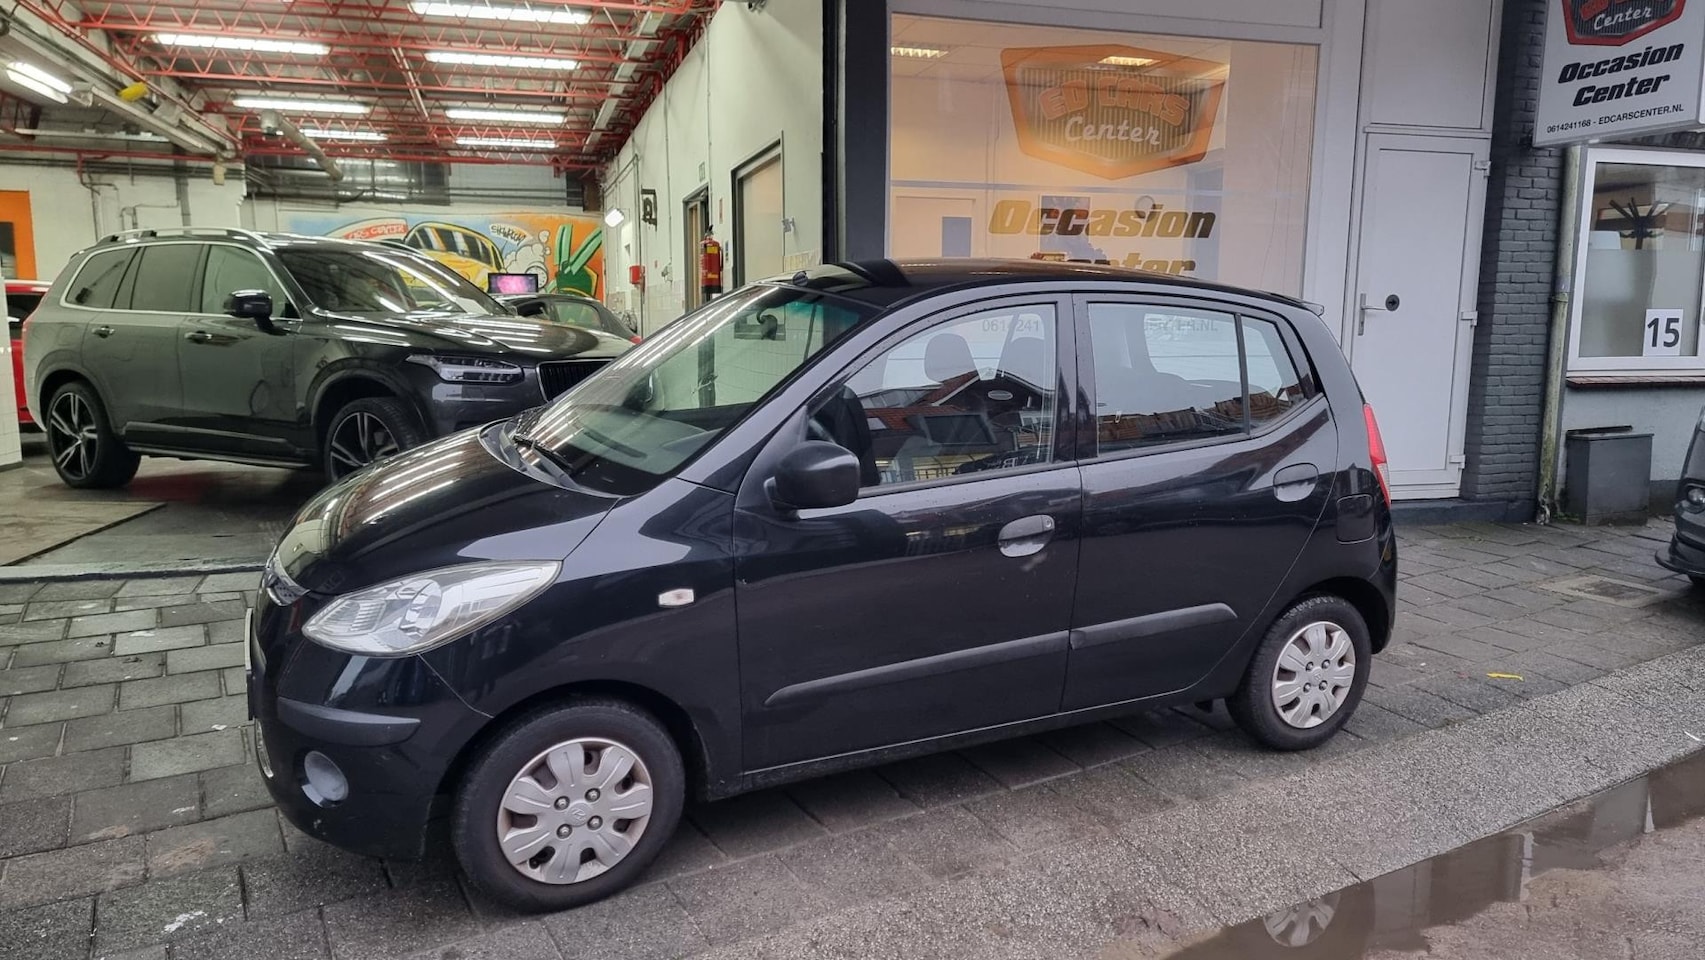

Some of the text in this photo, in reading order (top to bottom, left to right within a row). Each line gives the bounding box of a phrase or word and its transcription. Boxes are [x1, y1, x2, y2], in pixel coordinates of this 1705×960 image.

[1593, 7, 1653, 31] Center
[1558, 43, 1685, 84] Occasion
[1039, 76, 1190, 127] ED CARS
[1572, 74, 1671, 107] Center
[1065, 115, 1161, 146] Center
[1546, 119, 1592, 134] 0614241168
[1598, 103, 1684, 125] EDCARSCENTER.NL
[988, 199, 1217, 239] Occasion
[982, 319, 1039, 332] 061241
[1646, 317, 1680, 348] 15
